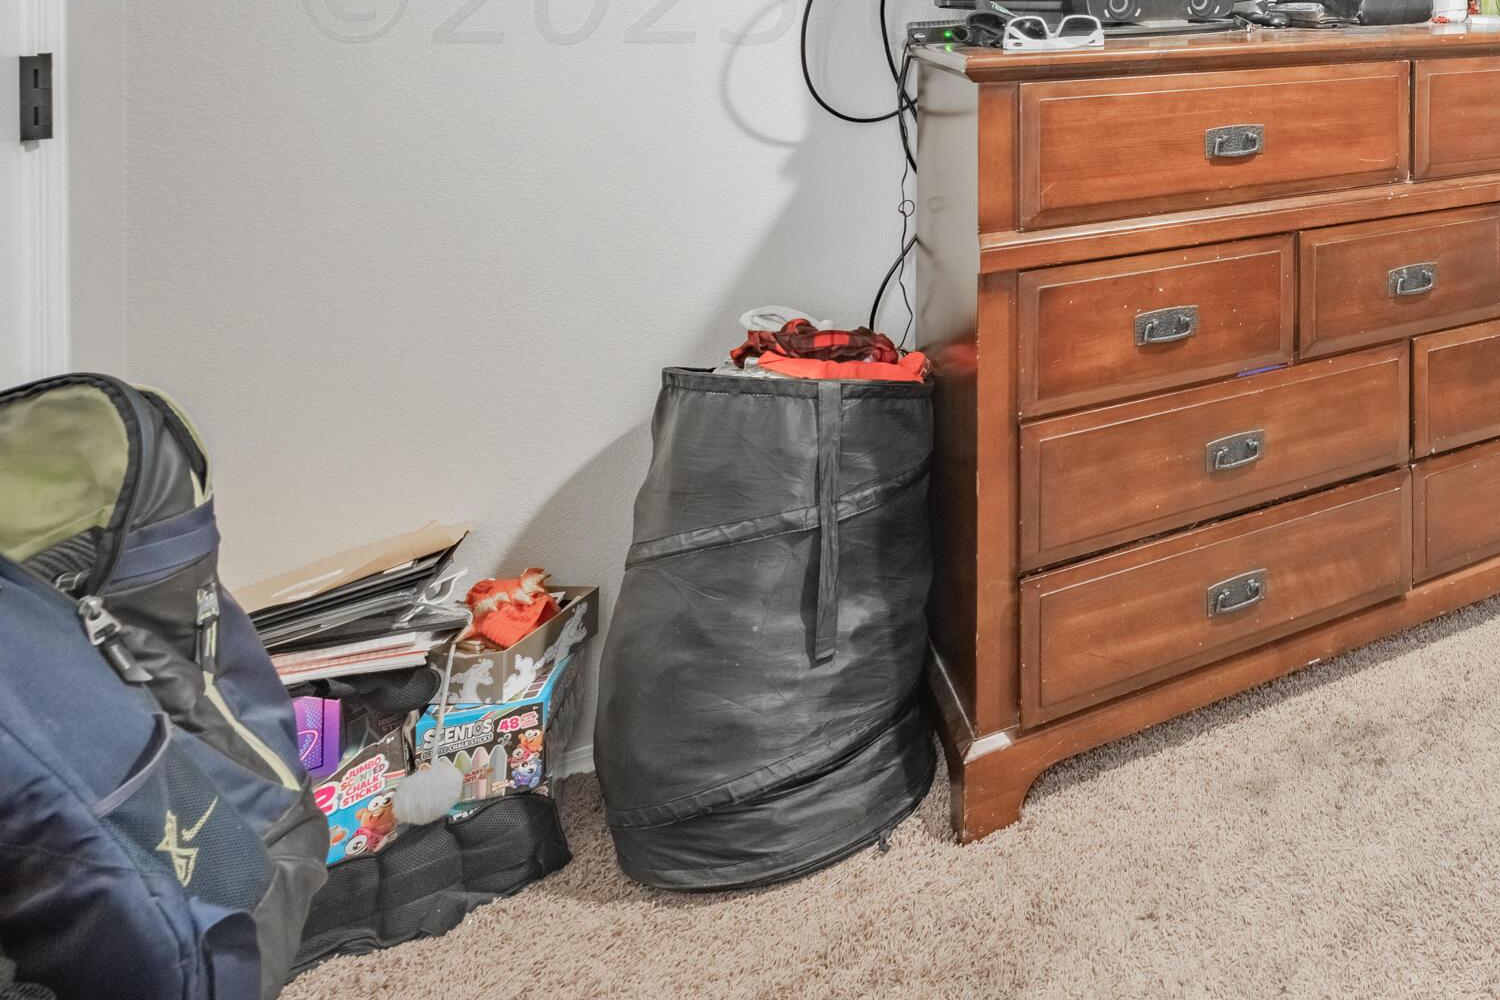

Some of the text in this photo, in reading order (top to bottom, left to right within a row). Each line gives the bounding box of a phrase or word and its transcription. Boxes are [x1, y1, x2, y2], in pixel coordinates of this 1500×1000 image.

[422, 718, 494, 750] SENTOS
[499, 717, 521, 732] 48
[346, 757, 381, 779] JUMBO
[341, 782, 382, 807] STICKS!
[346, 774, 381, 796] CHALK
